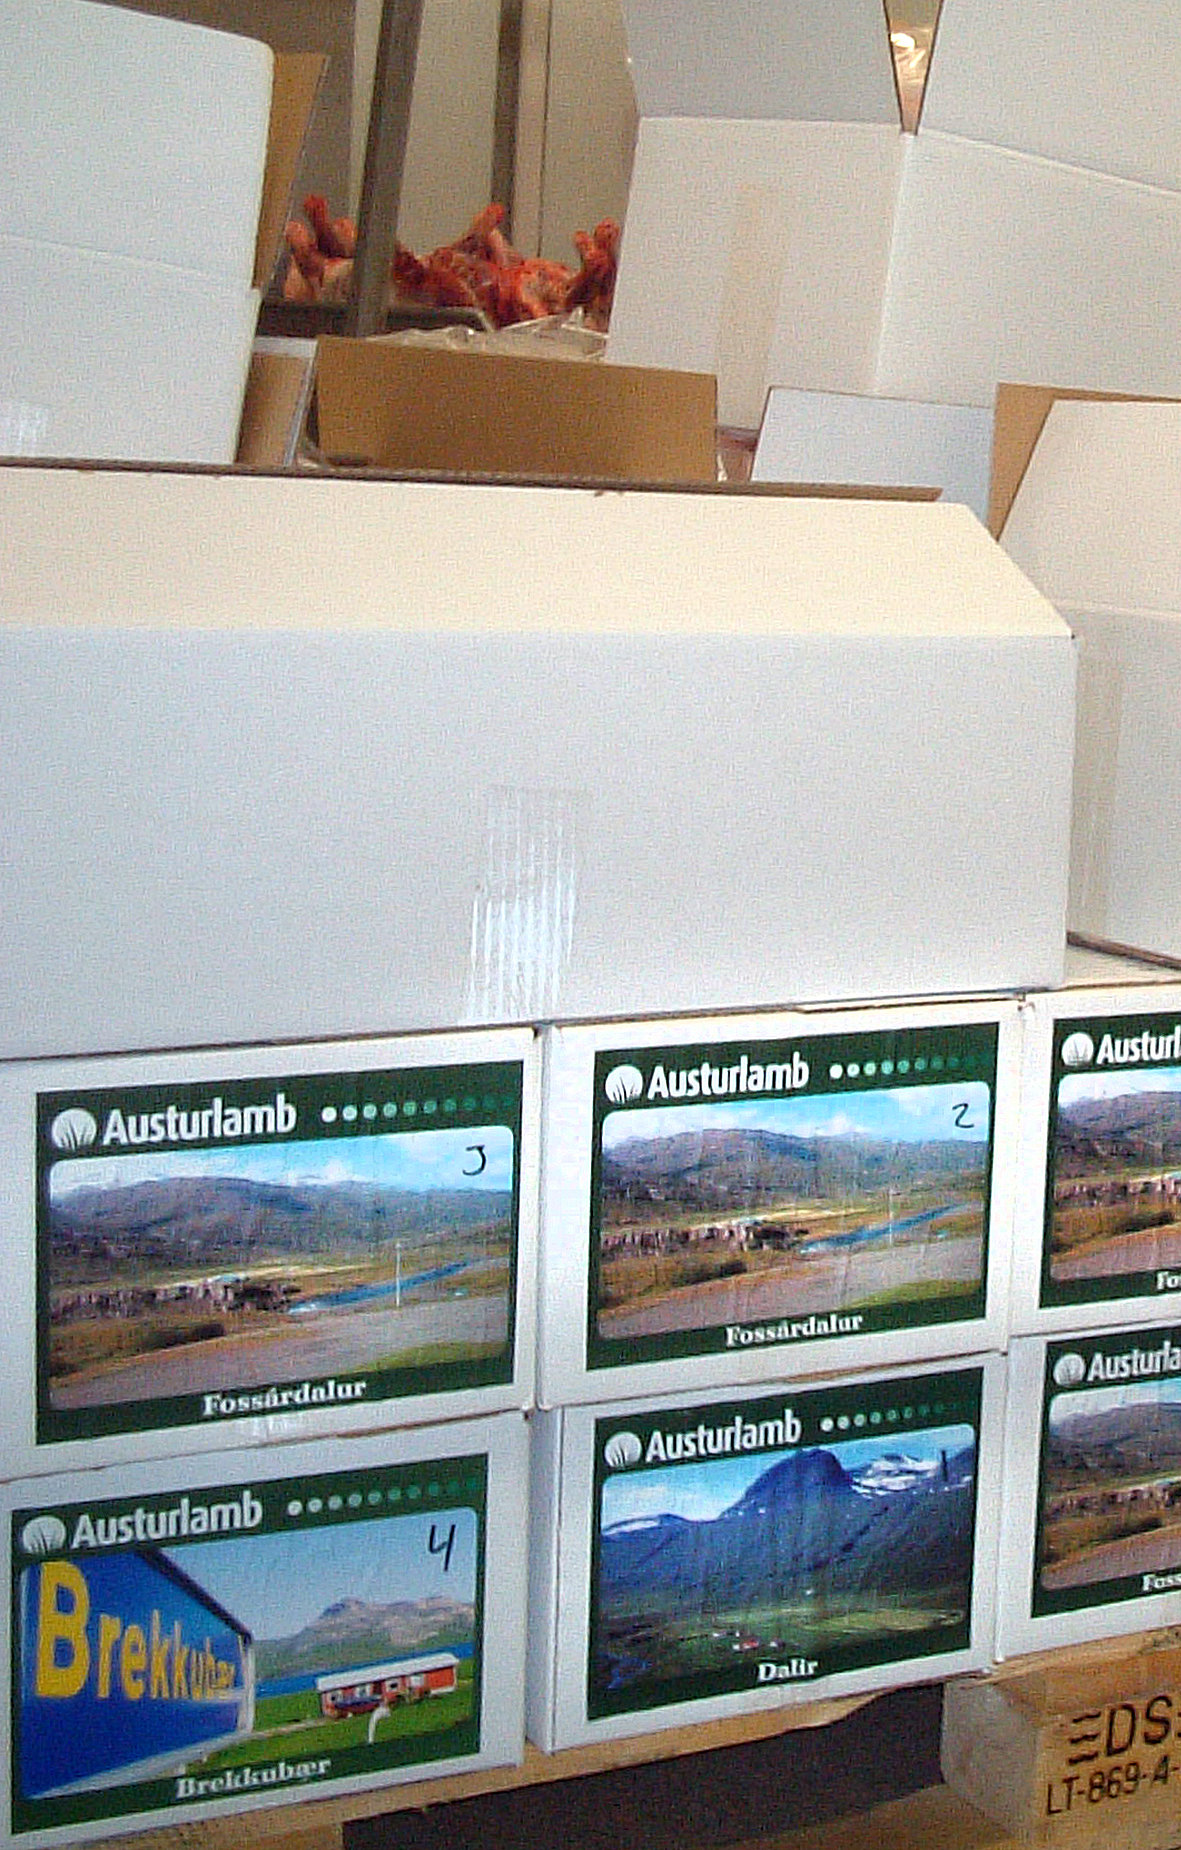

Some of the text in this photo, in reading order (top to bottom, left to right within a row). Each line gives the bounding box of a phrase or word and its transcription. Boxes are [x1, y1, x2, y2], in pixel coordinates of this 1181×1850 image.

[648, 1052, 809, 1100] Austurlamb
[102, 1093, 297, 1146] Austurlamb
[952, 1103, 975, 1128] 2
[646, 1409, 801, 1463] Austurlamb
[71, 1491, 263, 1549] Austurlamb
[428, 1523, 456, 1572] 4
[758, 1659, 818, 1682] Dalir
